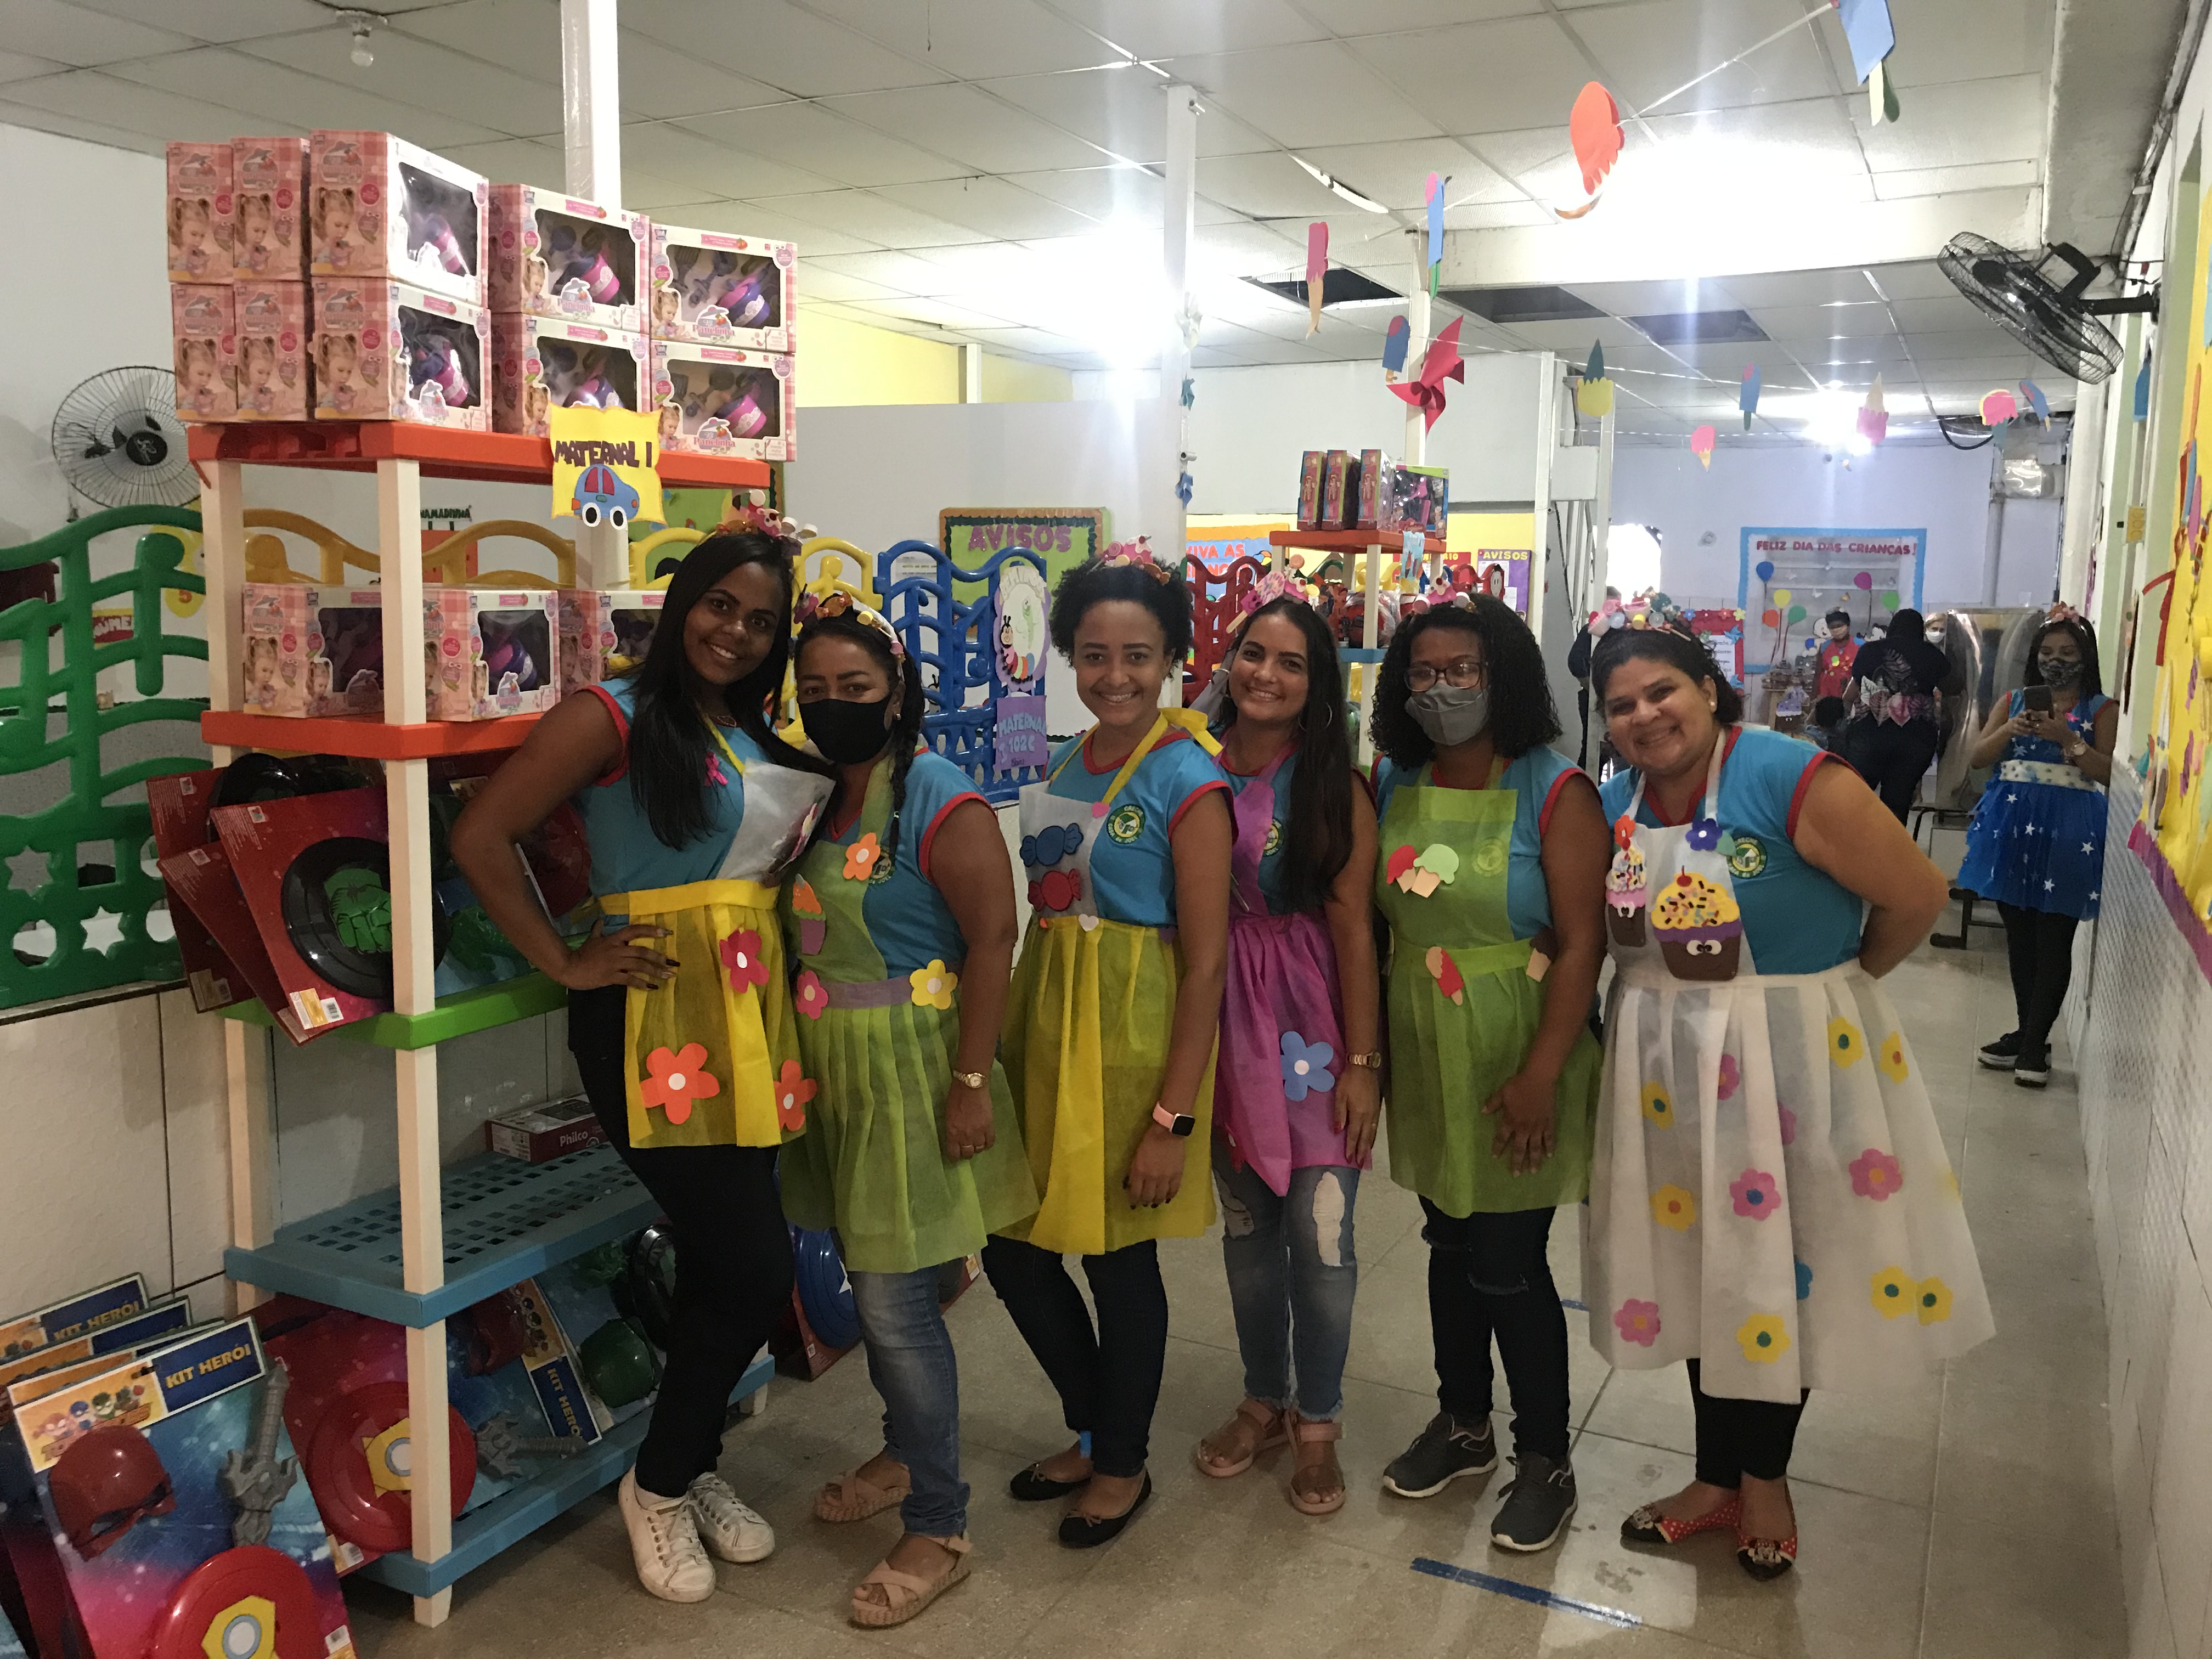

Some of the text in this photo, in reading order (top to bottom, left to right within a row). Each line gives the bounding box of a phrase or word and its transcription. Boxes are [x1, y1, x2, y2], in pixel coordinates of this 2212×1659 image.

[692, 324, 734, 336] Panelinha
[693, 437, 736, 448] Panelinha
[554, 440, 640, 468] MATERNAL
[968, 523, 1071, 552] AVISOS
[1186, 543, 1245, 558] VIVA AS
[1483, 550, 1528, 561] AVISOS
[1757, 541, 1917, 556] FELIZ DIA DAS CRIANÇAS!
[560, 1131, 588, 1147] Philco
[87, 1300, 139, 1329] HERÓI
[166, 1343, 251, 1389] KIT HERÓI
[547, 1368, 583, 1438] KIT HERÓ
